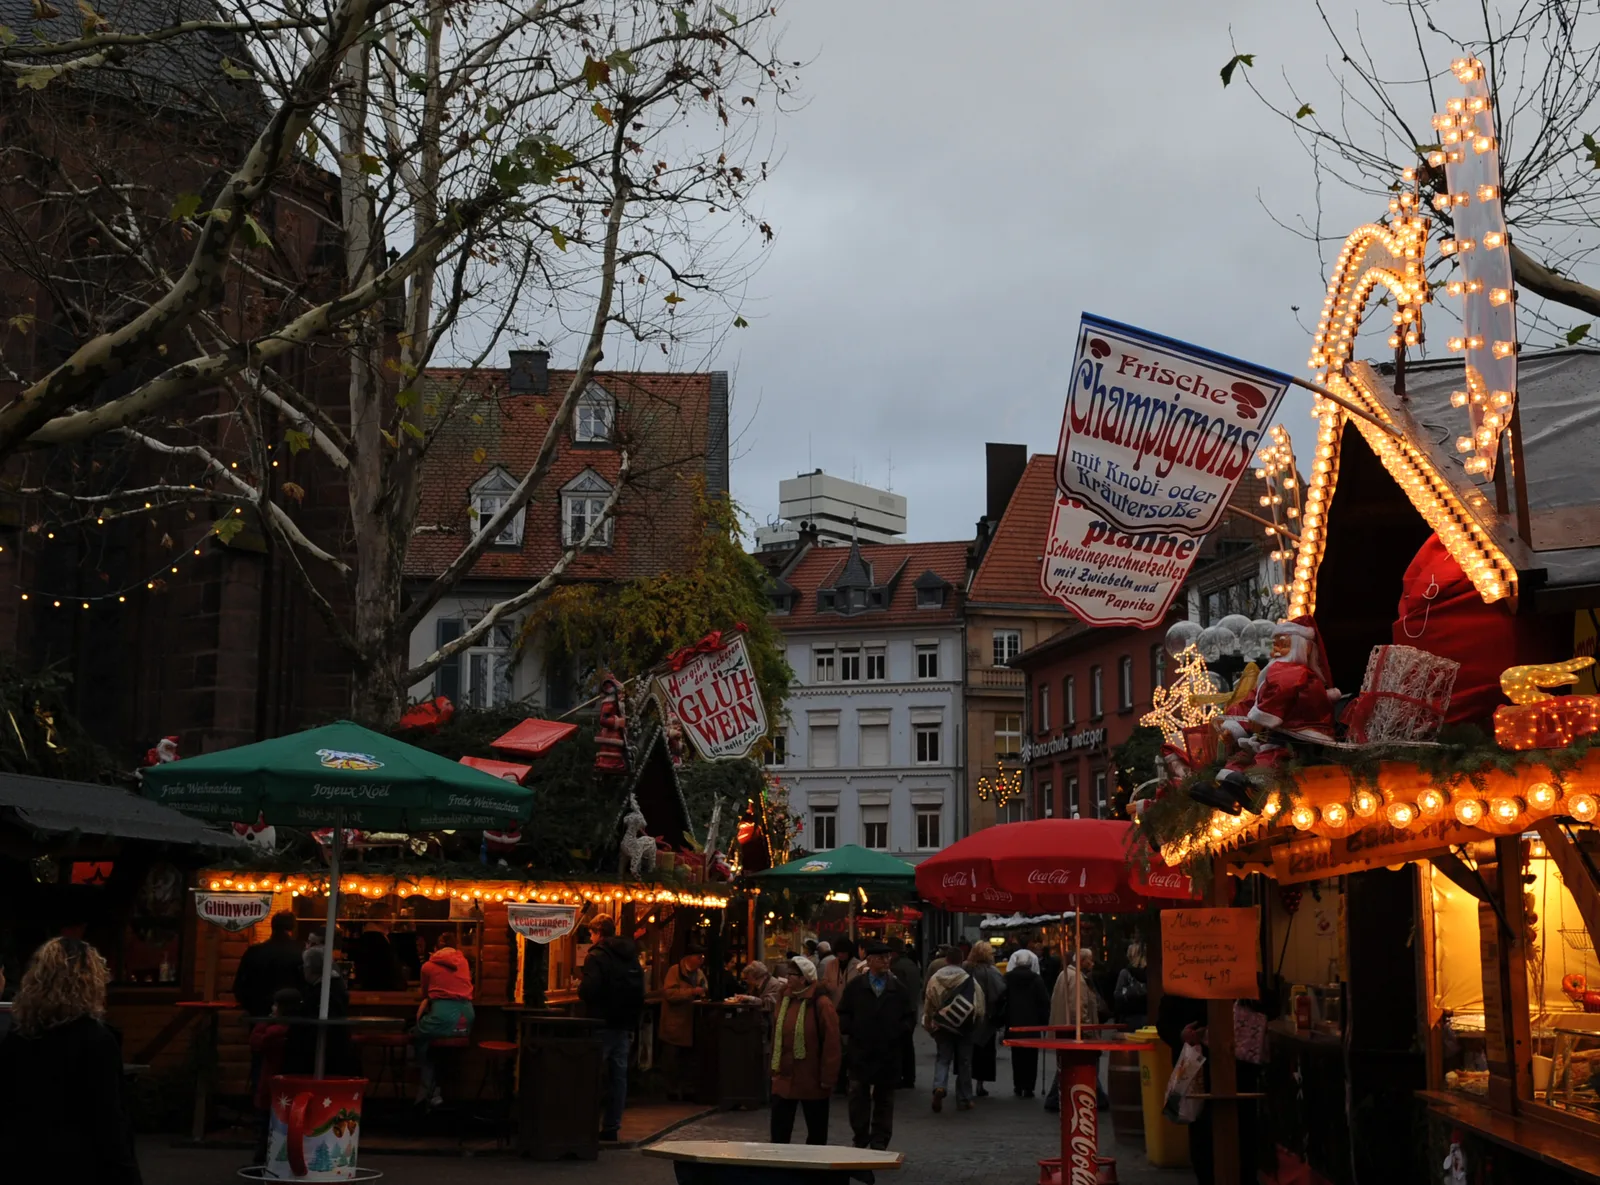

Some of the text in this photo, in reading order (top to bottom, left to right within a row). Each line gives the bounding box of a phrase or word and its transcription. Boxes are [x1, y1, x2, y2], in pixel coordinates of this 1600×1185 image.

[1116, 354, 1228, 404] Frische
[1071, 358, 1260, 481] Champignons
[1072, 450, 1217, 504] mit Knobi- oder
[1077, 466, 1202, 519] Kräutersoße
[1047, 537, 1186, 581] Schweinegeschnetzeltes
[1053, 567, 1158, 593] mit Zwiebeln und
[1053, 580, 1156, 612] frischem Paprika
[694, 642, 740, 686] den leckeren
[668, 675, 689, 698] Hier
[678, 669, 755, 725] GLÜH-
[694, 695, 759, 747] WEIN
[1071, 728, 1104, 750] metzger
[186, 782, 244, 796] Weihnachten
[311, 783, 393, 800] Joyeux Noël
[473, 796, 520, 814] Weihnachten
[205, 900, 262, 917] Glühwein
[514, 916, 571, 929] Feuerzangen-
